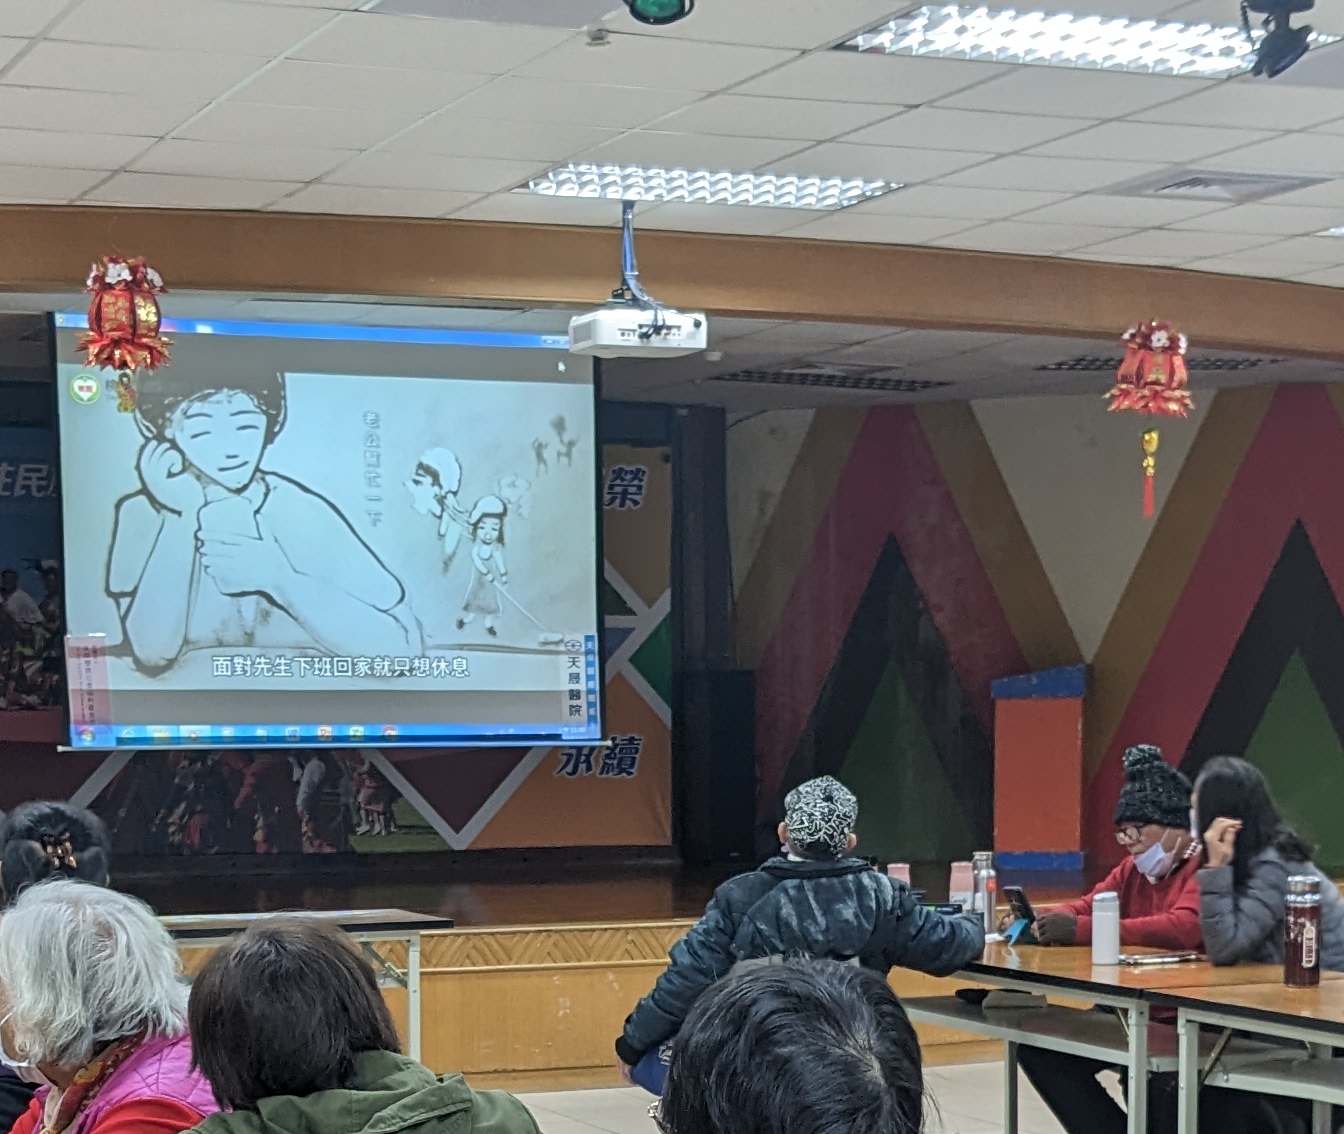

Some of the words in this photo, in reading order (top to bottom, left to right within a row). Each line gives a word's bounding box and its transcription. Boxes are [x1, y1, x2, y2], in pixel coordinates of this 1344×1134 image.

[603, 465, 647, 509] 榮
[211, 655, 471, 679] 面對先生下班回家就只想休息
[556, 735, 644, 777] 永續
